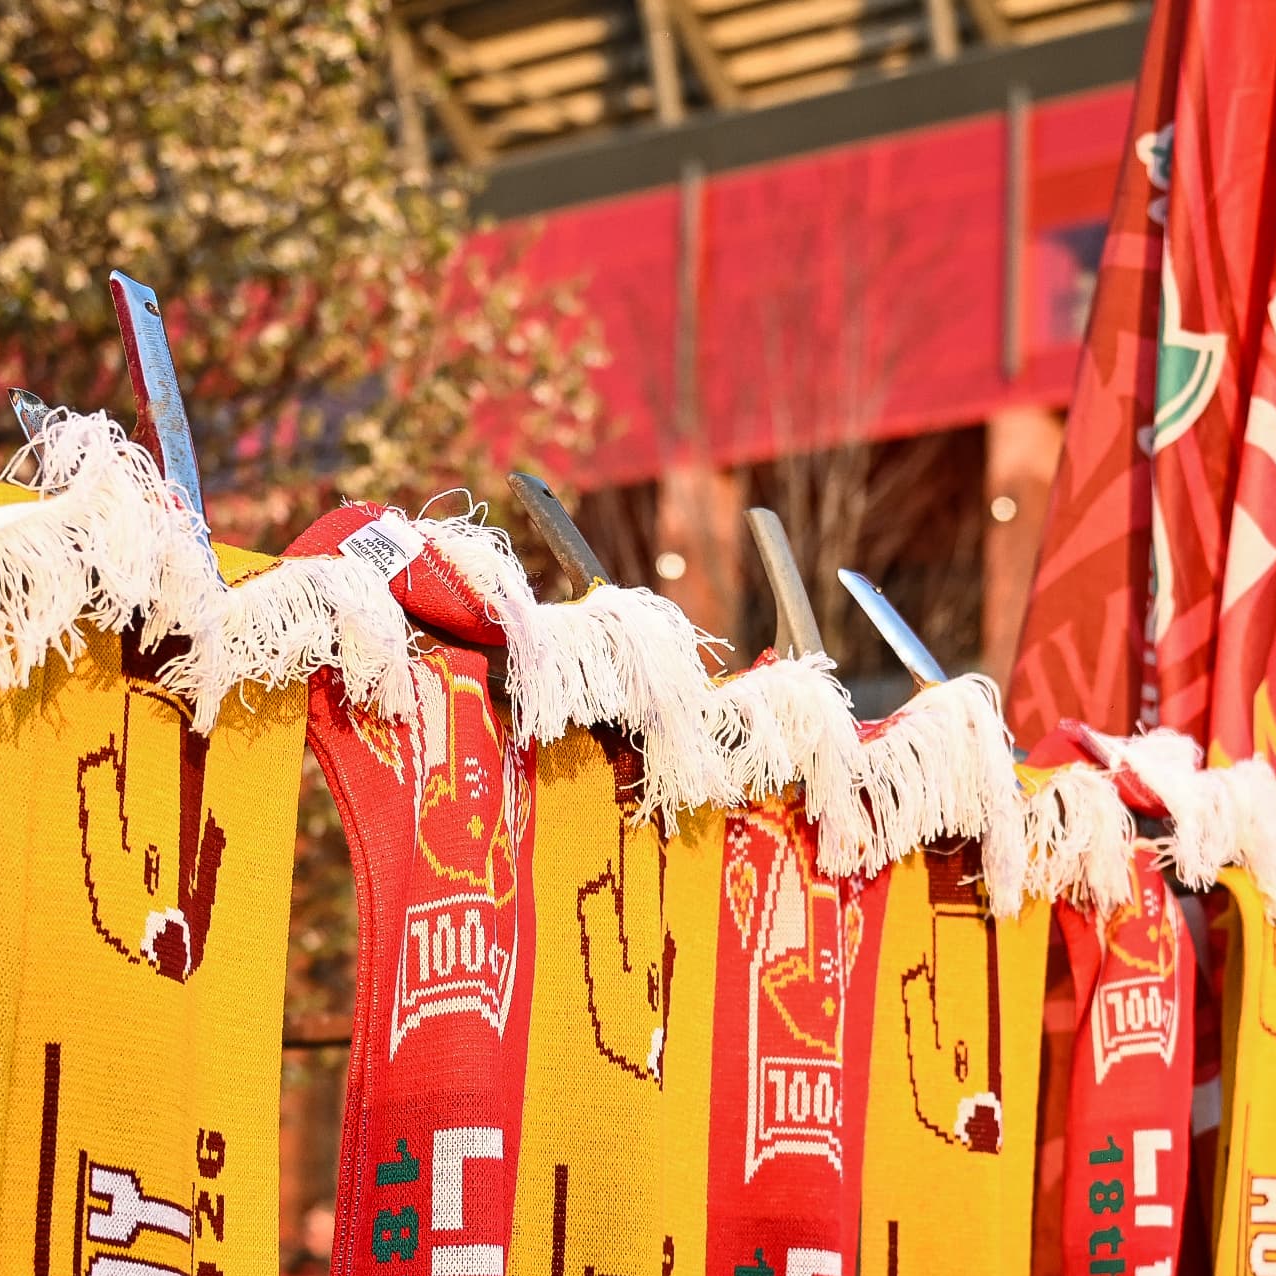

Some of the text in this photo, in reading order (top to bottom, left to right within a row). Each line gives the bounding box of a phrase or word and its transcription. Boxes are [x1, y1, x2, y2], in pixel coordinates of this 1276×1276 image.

[351, 539, 391, 578] UNOFFICIAL
[363, 538, 395, 566] TOTALLY
[373, 537, 397, 558] 100%
